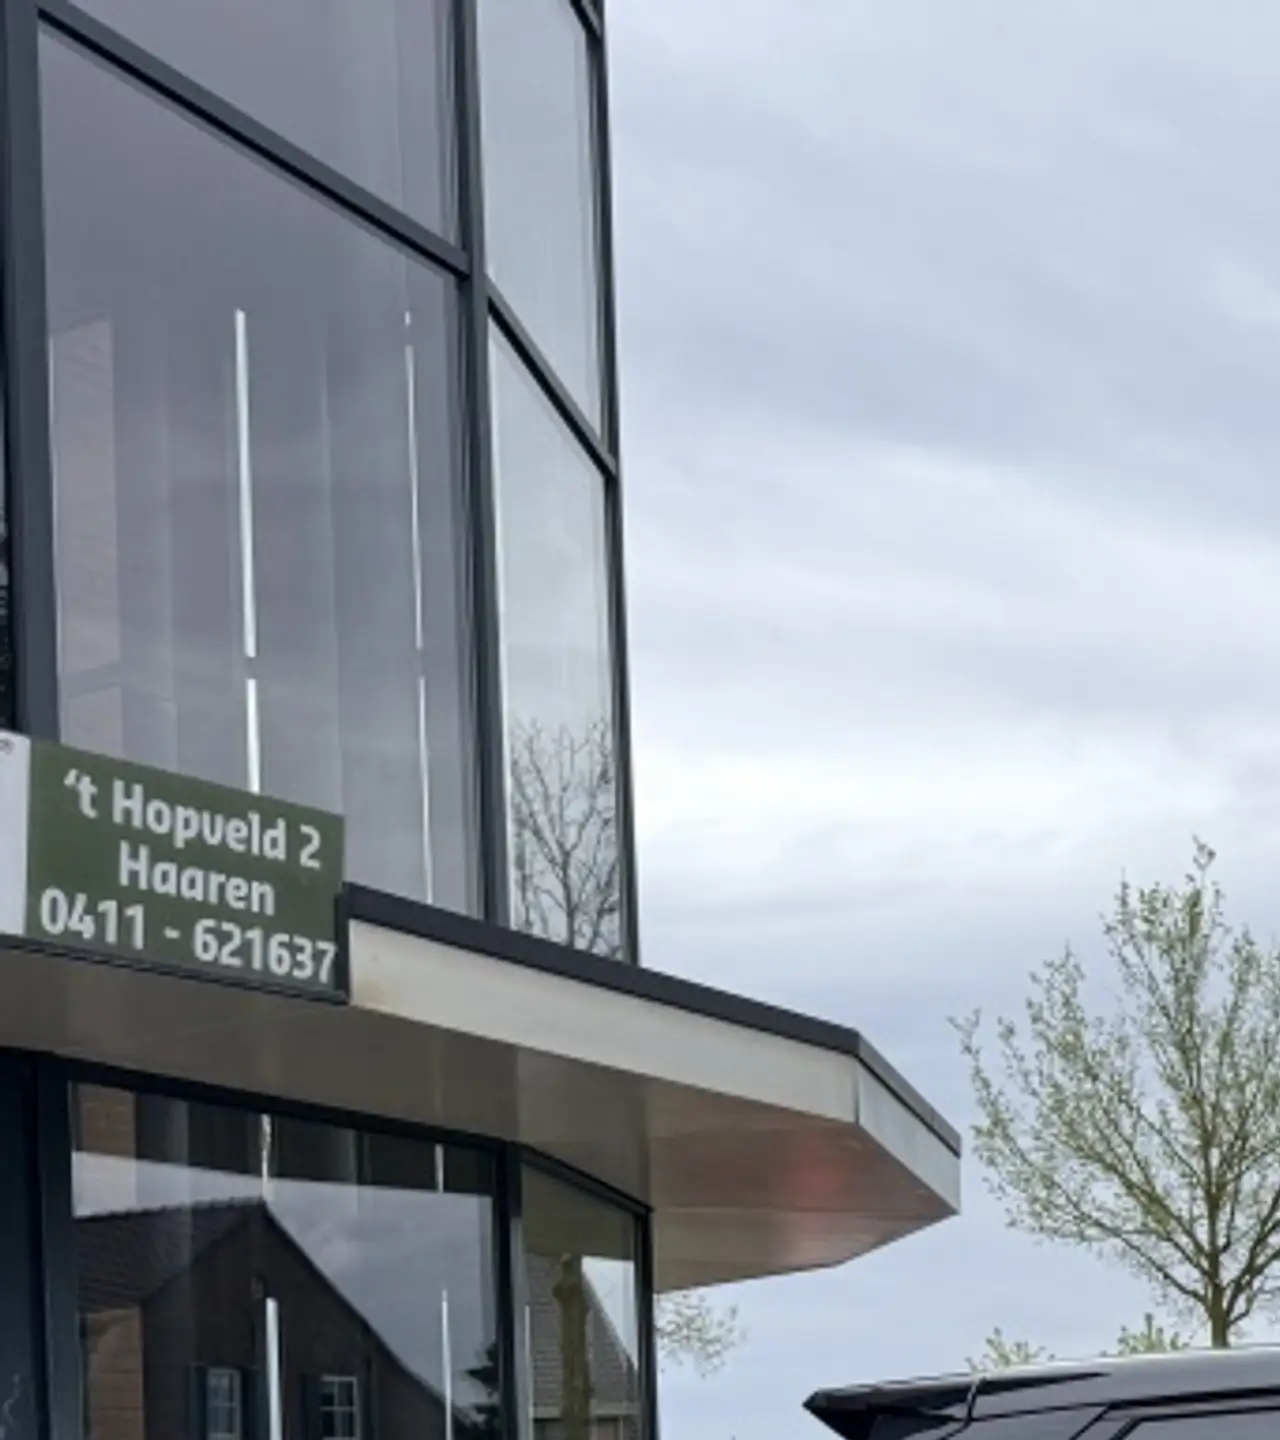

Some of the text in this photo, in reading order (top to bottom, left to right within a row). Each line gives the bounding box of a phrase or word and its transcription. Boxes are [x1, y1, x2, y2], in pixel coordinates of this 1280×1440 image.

[112, 779, 287, 861] Hopveld
[299, 824, 322, 870] 2
[119, 840, 276, 917] Haaren
[41, 886, 145, 950] 0411
[193, 918, 337, 984] 621637
